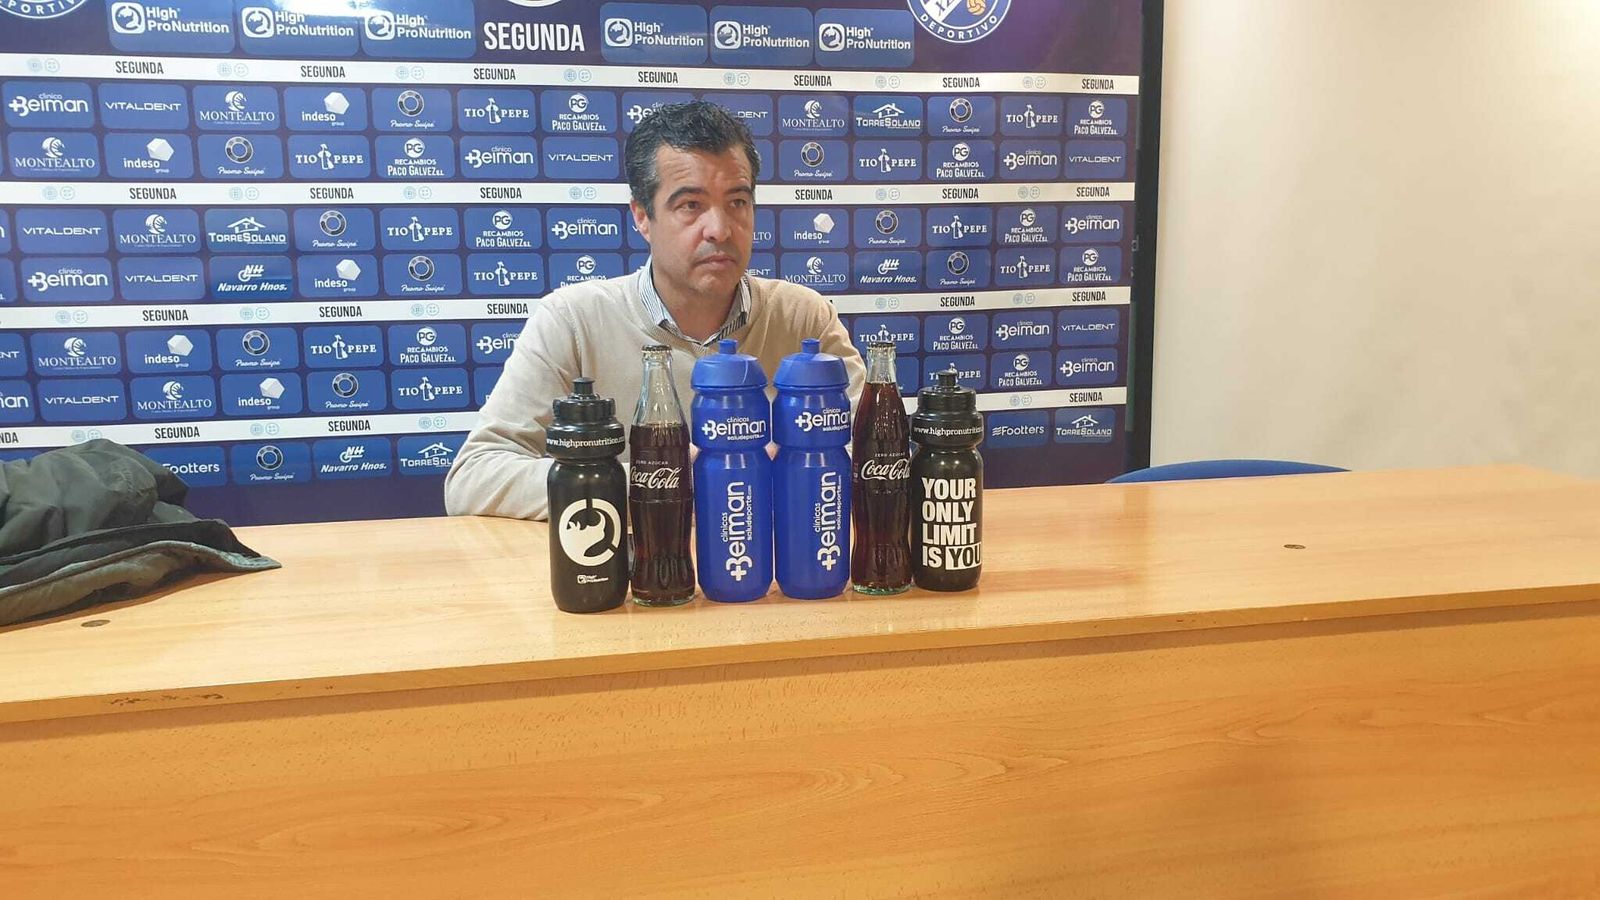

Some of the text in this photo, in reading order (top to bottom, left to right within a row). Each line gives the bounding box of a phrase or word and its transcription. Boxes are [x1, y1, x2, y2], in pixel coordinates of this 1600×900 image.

[146, 7, 177, 21] High
[395, 14, 425, 27] High
[147, 20, 229, 33] ProNutrition
[276, 24, 354, 36] ProNutrition
[634, 22, 660, 35] High
[743, 24, 768, 37] High
[919, 13, 998, 40] DEPORTIVO
[397, 27, 471, 39] ProNutrition
[484, 22, 585, 51] SEGUNDA
[846, 27, 871, 39] High
[635, 34, 703, 46] ProNutrition
[743, 36, 809, 47] ProNutrition
[847, 38, 911, 49] ProNutrition
[115, 61, 164, 74] SEGUNDA
[301, 65, 345, 78] SEGUNDA
[474, 68, 516, 80] SEGUNDA
[638, 71, 678, 83] SEGUNDA
[794, 75, 832, 86] SEGUNDA
[943, 77, 980, 88] SEGUNDA
[1082, 78, 1114, 90] SEGUNDA
[8, 96, 88, 116] Beiman
[105, 102, 181, 111] VITALDENT
[200, 109, 275, 121] MONTEALTO
[302, 111, 336, 121] indeso
[464, 108, 529, 118] TIO PEPE
[1006, 114, 1058, 123] TIO PEPE
[552, 120, 571, 130] PACO
[782, 118, 844, 128] MONTEALTO
[1074, 125, 1089, 135] PACO
[15, 156, 95, 168] MONTEALTO
[123, 158, 160, 168] indeso
[295, 155, 363, 164] TIO PEPE
[465, 149, 533, 168] Beiman
[859, 159, 916, 167] TIO PEPE
[1003, 151, 1057, 170] Beiman
[387, 165, 407, 176] PACO
[936, 168, 953, 178] PACO
[129, 188, 177, 199] SEGUNDA
[310, 187, 354, 199] SEGUNDA
[480, 187, 522, 199] SEGUNDA
[795, 189, 832, 200] SEGUNDA
[942, 188, 979, 199] SEGUNDA
[1076, 186, 1110, 197] SEGUNDA
[551, 220, 617, 239] Beiman
[964, 225, 987, 233] PEPE
[1065, 216, 1119, 234] Beiman
[23, 227, 101, 235] VITALDENT
[387, 227, 453, 236] TIO PEPE
[794, 230, 822, 240] indeso
[120, 233, 196, 243] MONTEALTO
[476, 237, 495, 247] PACO
[1005, 232, 1022, 243] PACO
[1028, 264, 1050, 272] PEPE
[28, 270, 108, 291] Beiman
[125, 274, 198, 282] VITALDENT
[474, 272, 538, 280] TIO PEPE
[783, 274, 846, 286] MONTEALTO
[860, 275, 917, 283] Navarro Hnos.
[1067, 272, 1082, 282] PACO
[217, 282, 287, 291] Navarro Hnos.
[314, 278, 347, 288] indeso
[940, 296, 975, 307] SEGUNDA
[1072, 291, 1106, 302] SEGUNDA
[319, 306, 362, 317] SEGUNDA
[487, 303, 528, 314] SEGUNDA
[142, 309, 189, 321] SEGUNDA
[996, 322, 1049, 340] Beiman
[1061, 323, 1115, 331] VITALDENT
[890, 332, 915, 341] PEPE
[310, 344, 376, 354] TIO PEPE
[933, 341, 949, 350] PACO
[38, 353, 116, 366] MONTEALTO
[145, 354, 180, 364] indeso
[400, 353, 419, 363] PACO
[1060, 360, 1114, 377] Beiman
[959, 370, 981, 379] PEPE
[999, 376, 1016, 387] PACO
[398, 386, 463, 396] TIO PEPE
[45, 396, 119, 404] VITALDENT
[238, 397, 271, 406] indeso
[1069, 392, 1103, 402] SEGUNDA
[137, 397, 212, 410] MONTEALTO
[328, 420, 371, 432] SEGUNDA
[701, 419, 767, 440] Beiman
[1002, 425, 1044, 436] Footters
[155, 426, 200, 439] SEGUNDA
[360, 462, 386, 470] Hnos.
[921, 477, 976, 500] YOUR
[921, 500, 974, 523] ONLY
[817, 471, 841, 571] Beiman
[725, 481, 753, 582] Beiman
[922, 523, 977, 546] LIMIT
[922, 546, 981, 569] IS YOU
